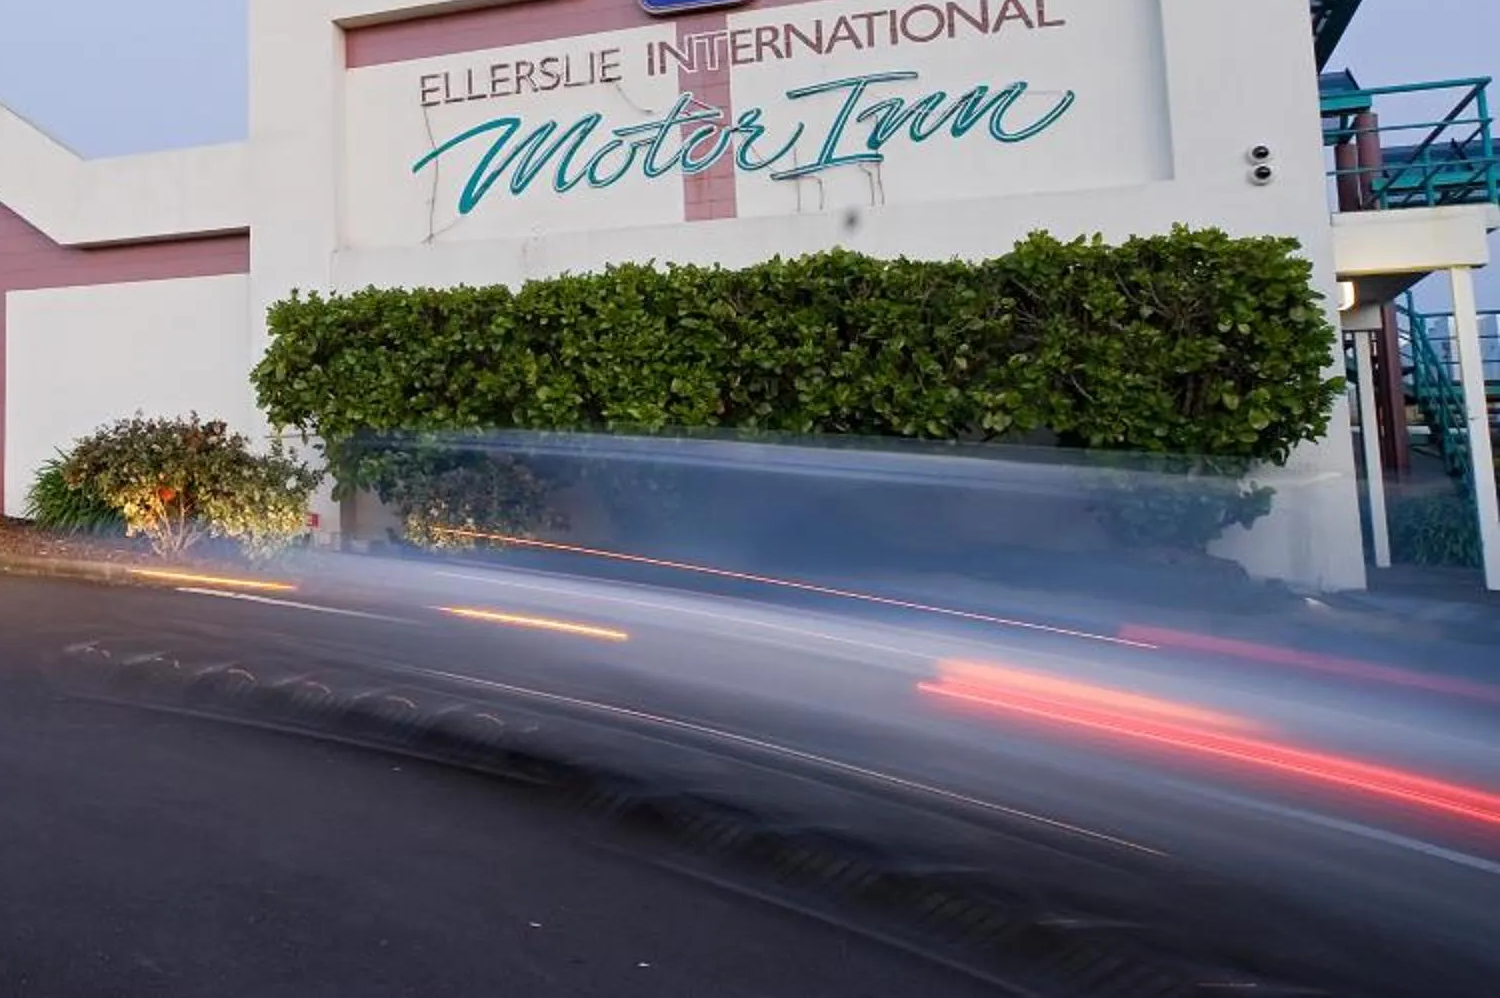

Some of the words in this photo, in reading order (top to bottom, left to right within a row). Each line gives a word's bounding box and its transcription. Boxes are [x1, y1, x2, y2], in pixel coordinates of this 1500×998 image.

[420, 48, 622, 107] ELLERSLIE
[412, 92, 804, 215] Motor
[770, 71, 1076, 180] Inn
